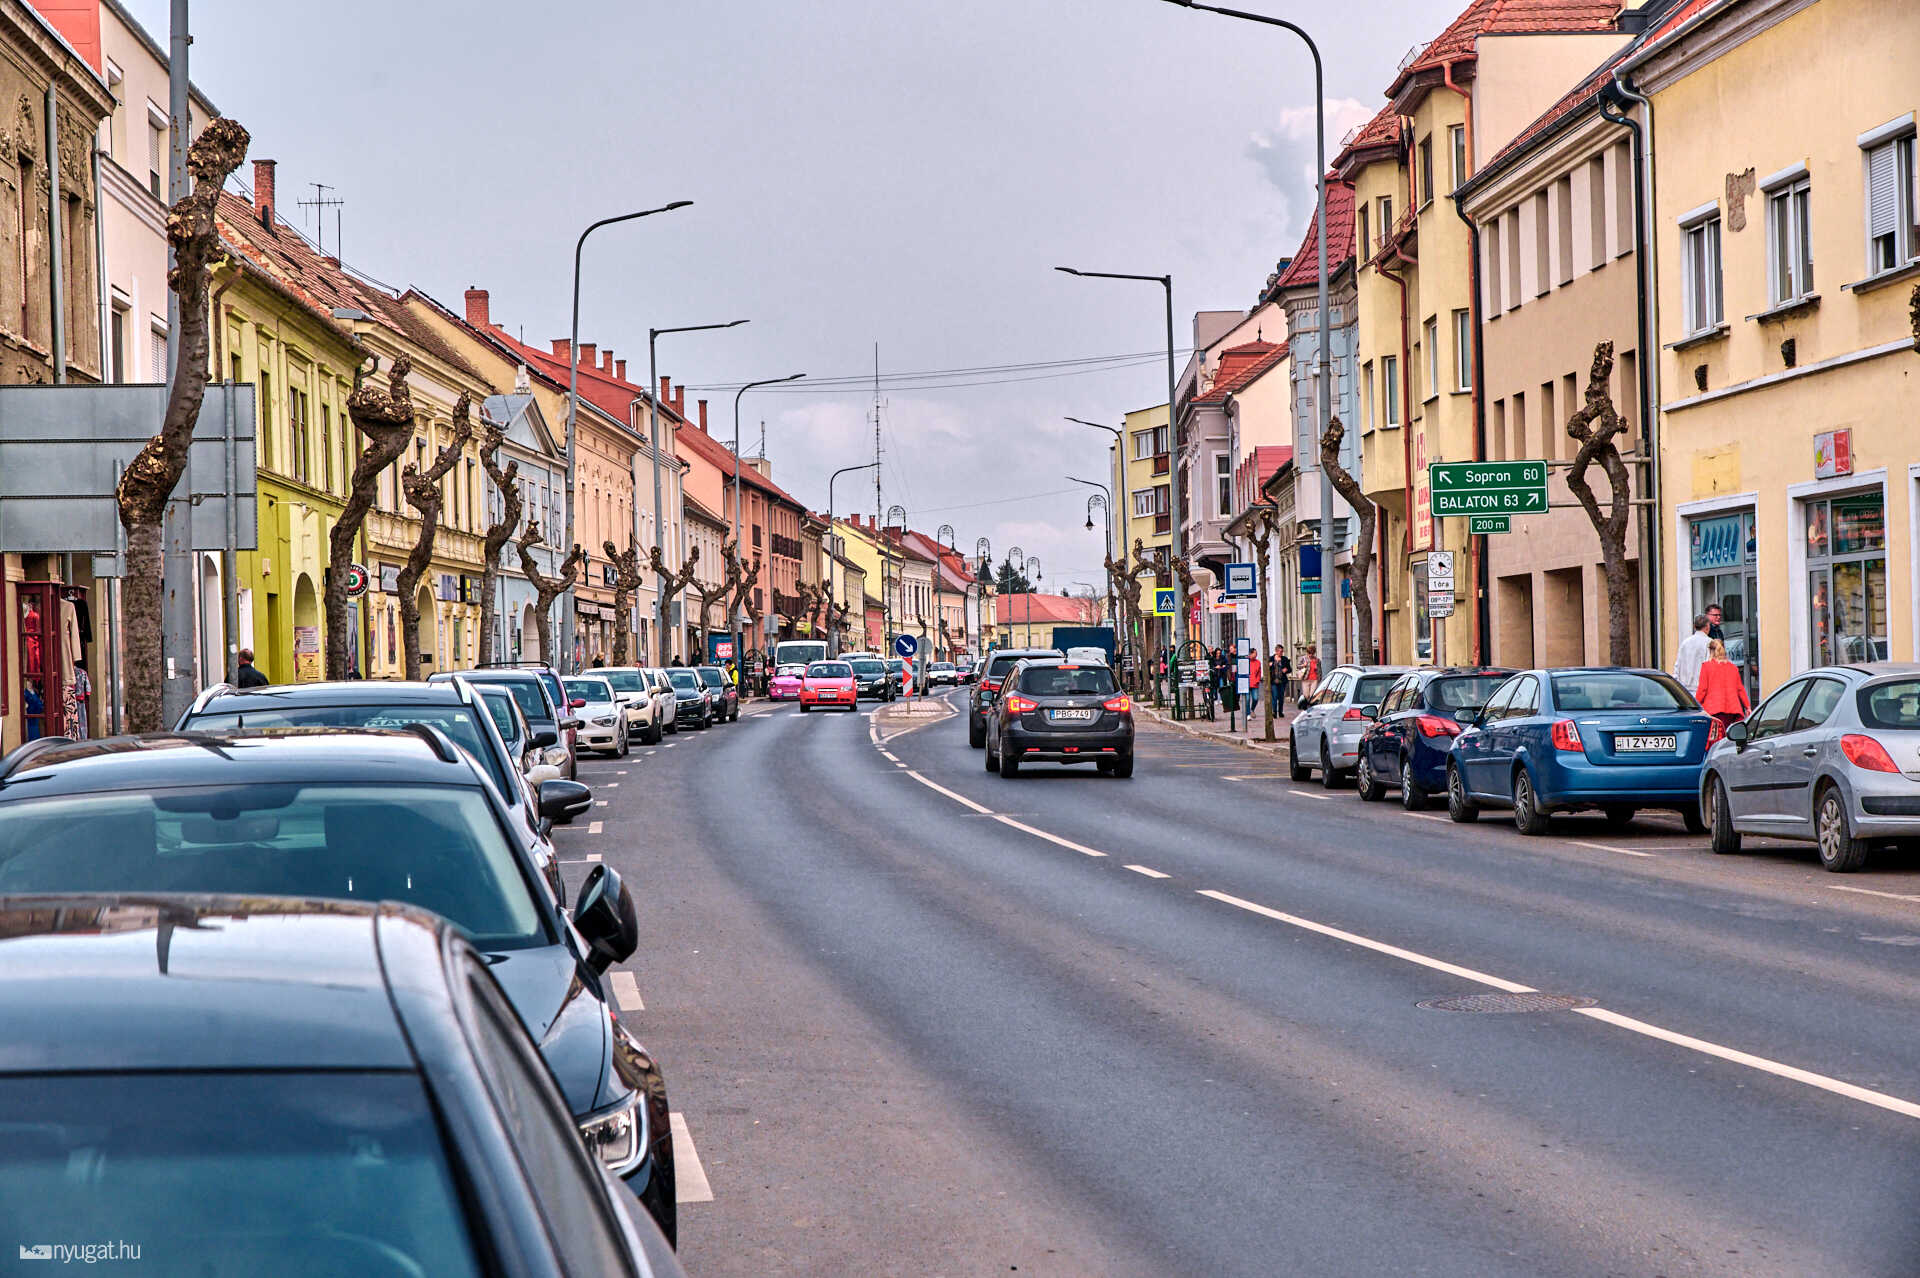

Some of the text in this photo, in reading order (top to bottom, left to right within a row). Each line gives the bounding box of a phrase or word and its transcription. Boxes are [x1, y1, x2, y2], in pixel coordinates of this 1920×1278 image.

[1465, 468, 1539, 485] Sopron 60
[1439, 495, 1498, 509] BALATON
[1503, 494, 1519, 507] 63
[1476, 520, 1505, 530] 200 m
[1055, 710, 1089, 718] PBG-749
[1626, 737, 1675, 748] IZY-370
